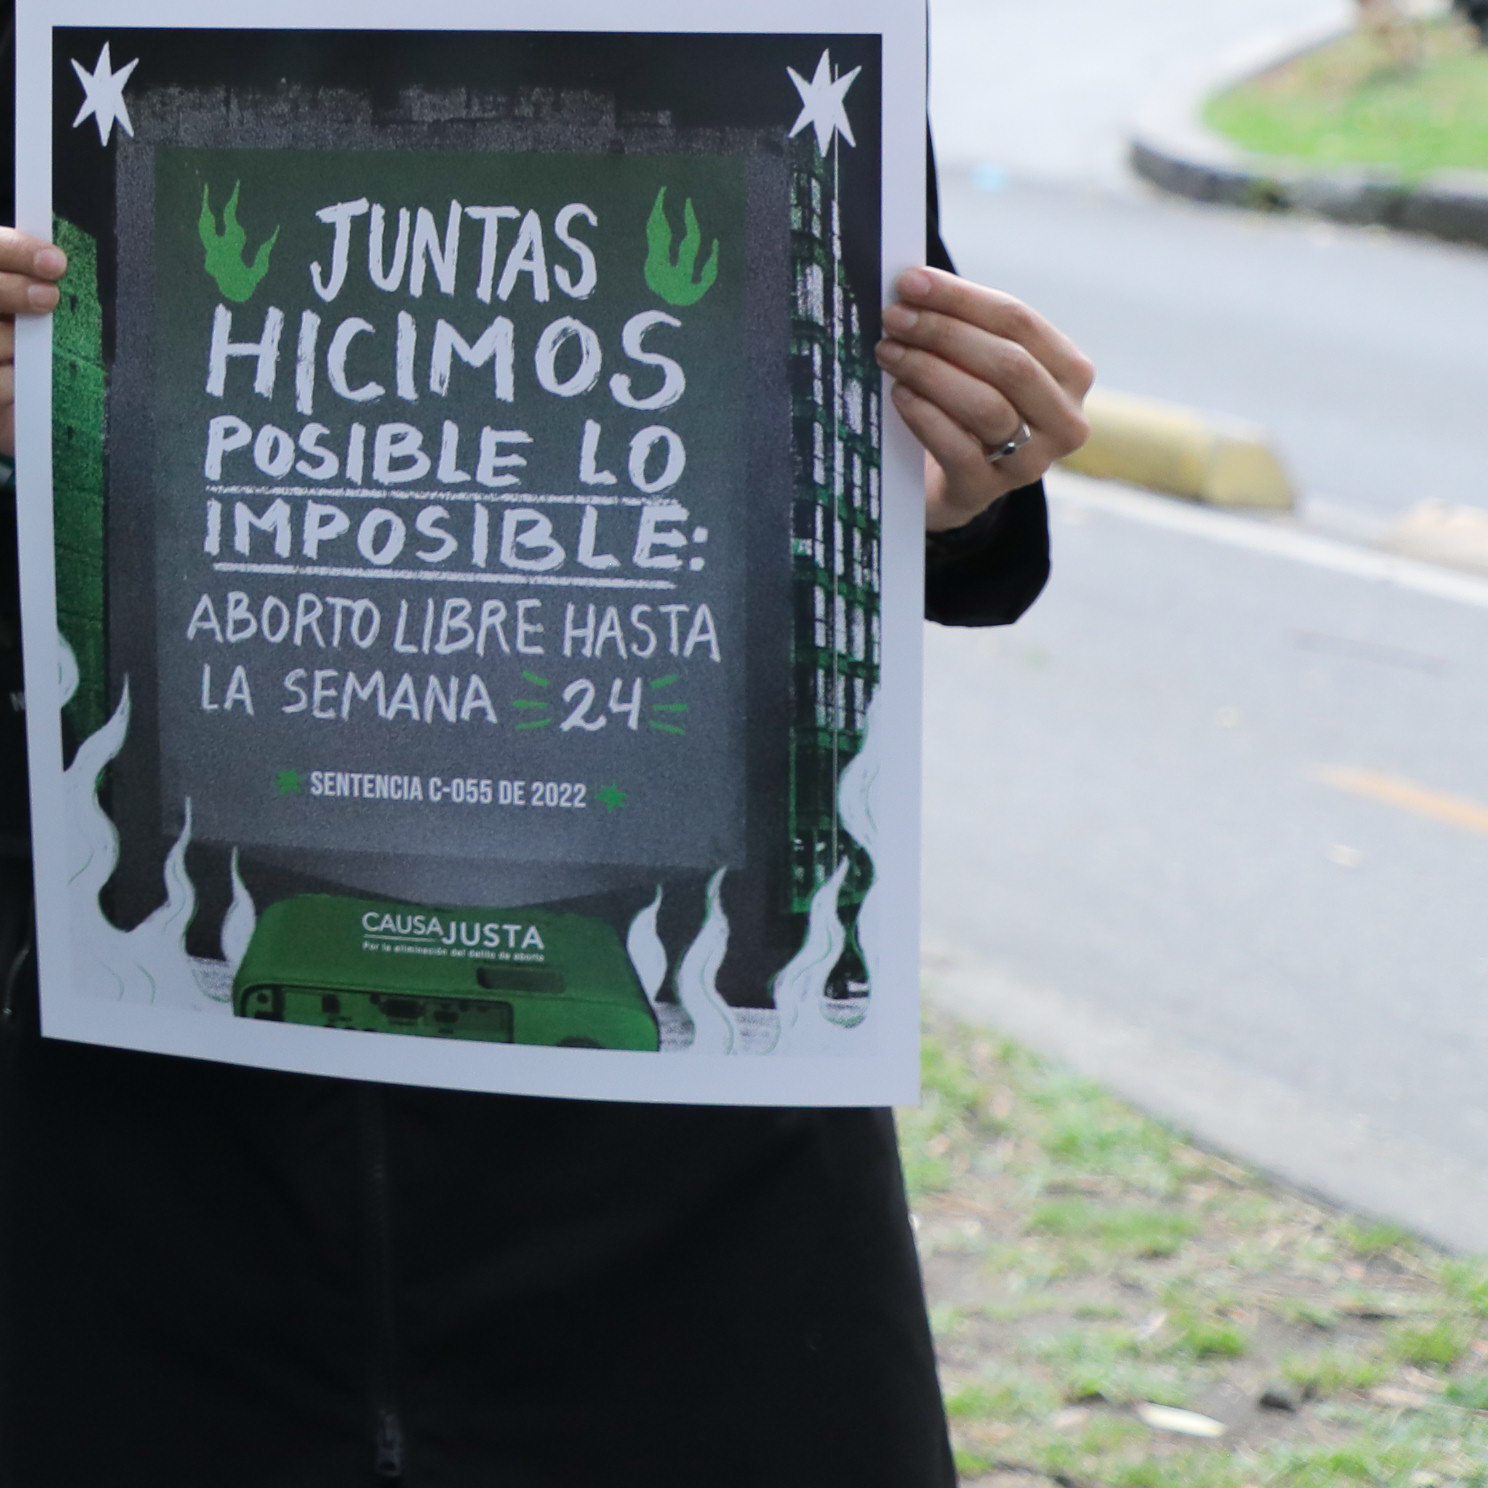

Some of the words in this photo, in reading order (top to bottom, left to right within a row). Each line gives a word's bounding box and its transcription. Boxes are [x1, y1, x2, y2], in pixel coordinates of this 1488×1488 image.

[310, 197, 598, 304] JUNTAS
[206, 303, 686, 414] HICIMOS
[204, 415, 533, 487] POSIBLE
[579, 419, 686, 494] LO
[203, 499, 709, 572] IMPOSIBLE:
[186, 592, 380, 649] ABORTO
[394, 597, 544, 657] LIBRE
[563, 602, 720, 662] HASTA
[200, 663, 254, 714] LA
[282, 668, 498, 725] SEMANA
[560, 677, 642, 731] 24
[310, 771, 423, 801] SENTENCIA
[428, 777, 493, 803] C-055
[498, 780, 525, 805] DE
[531, 782, 587, 808] 2022
